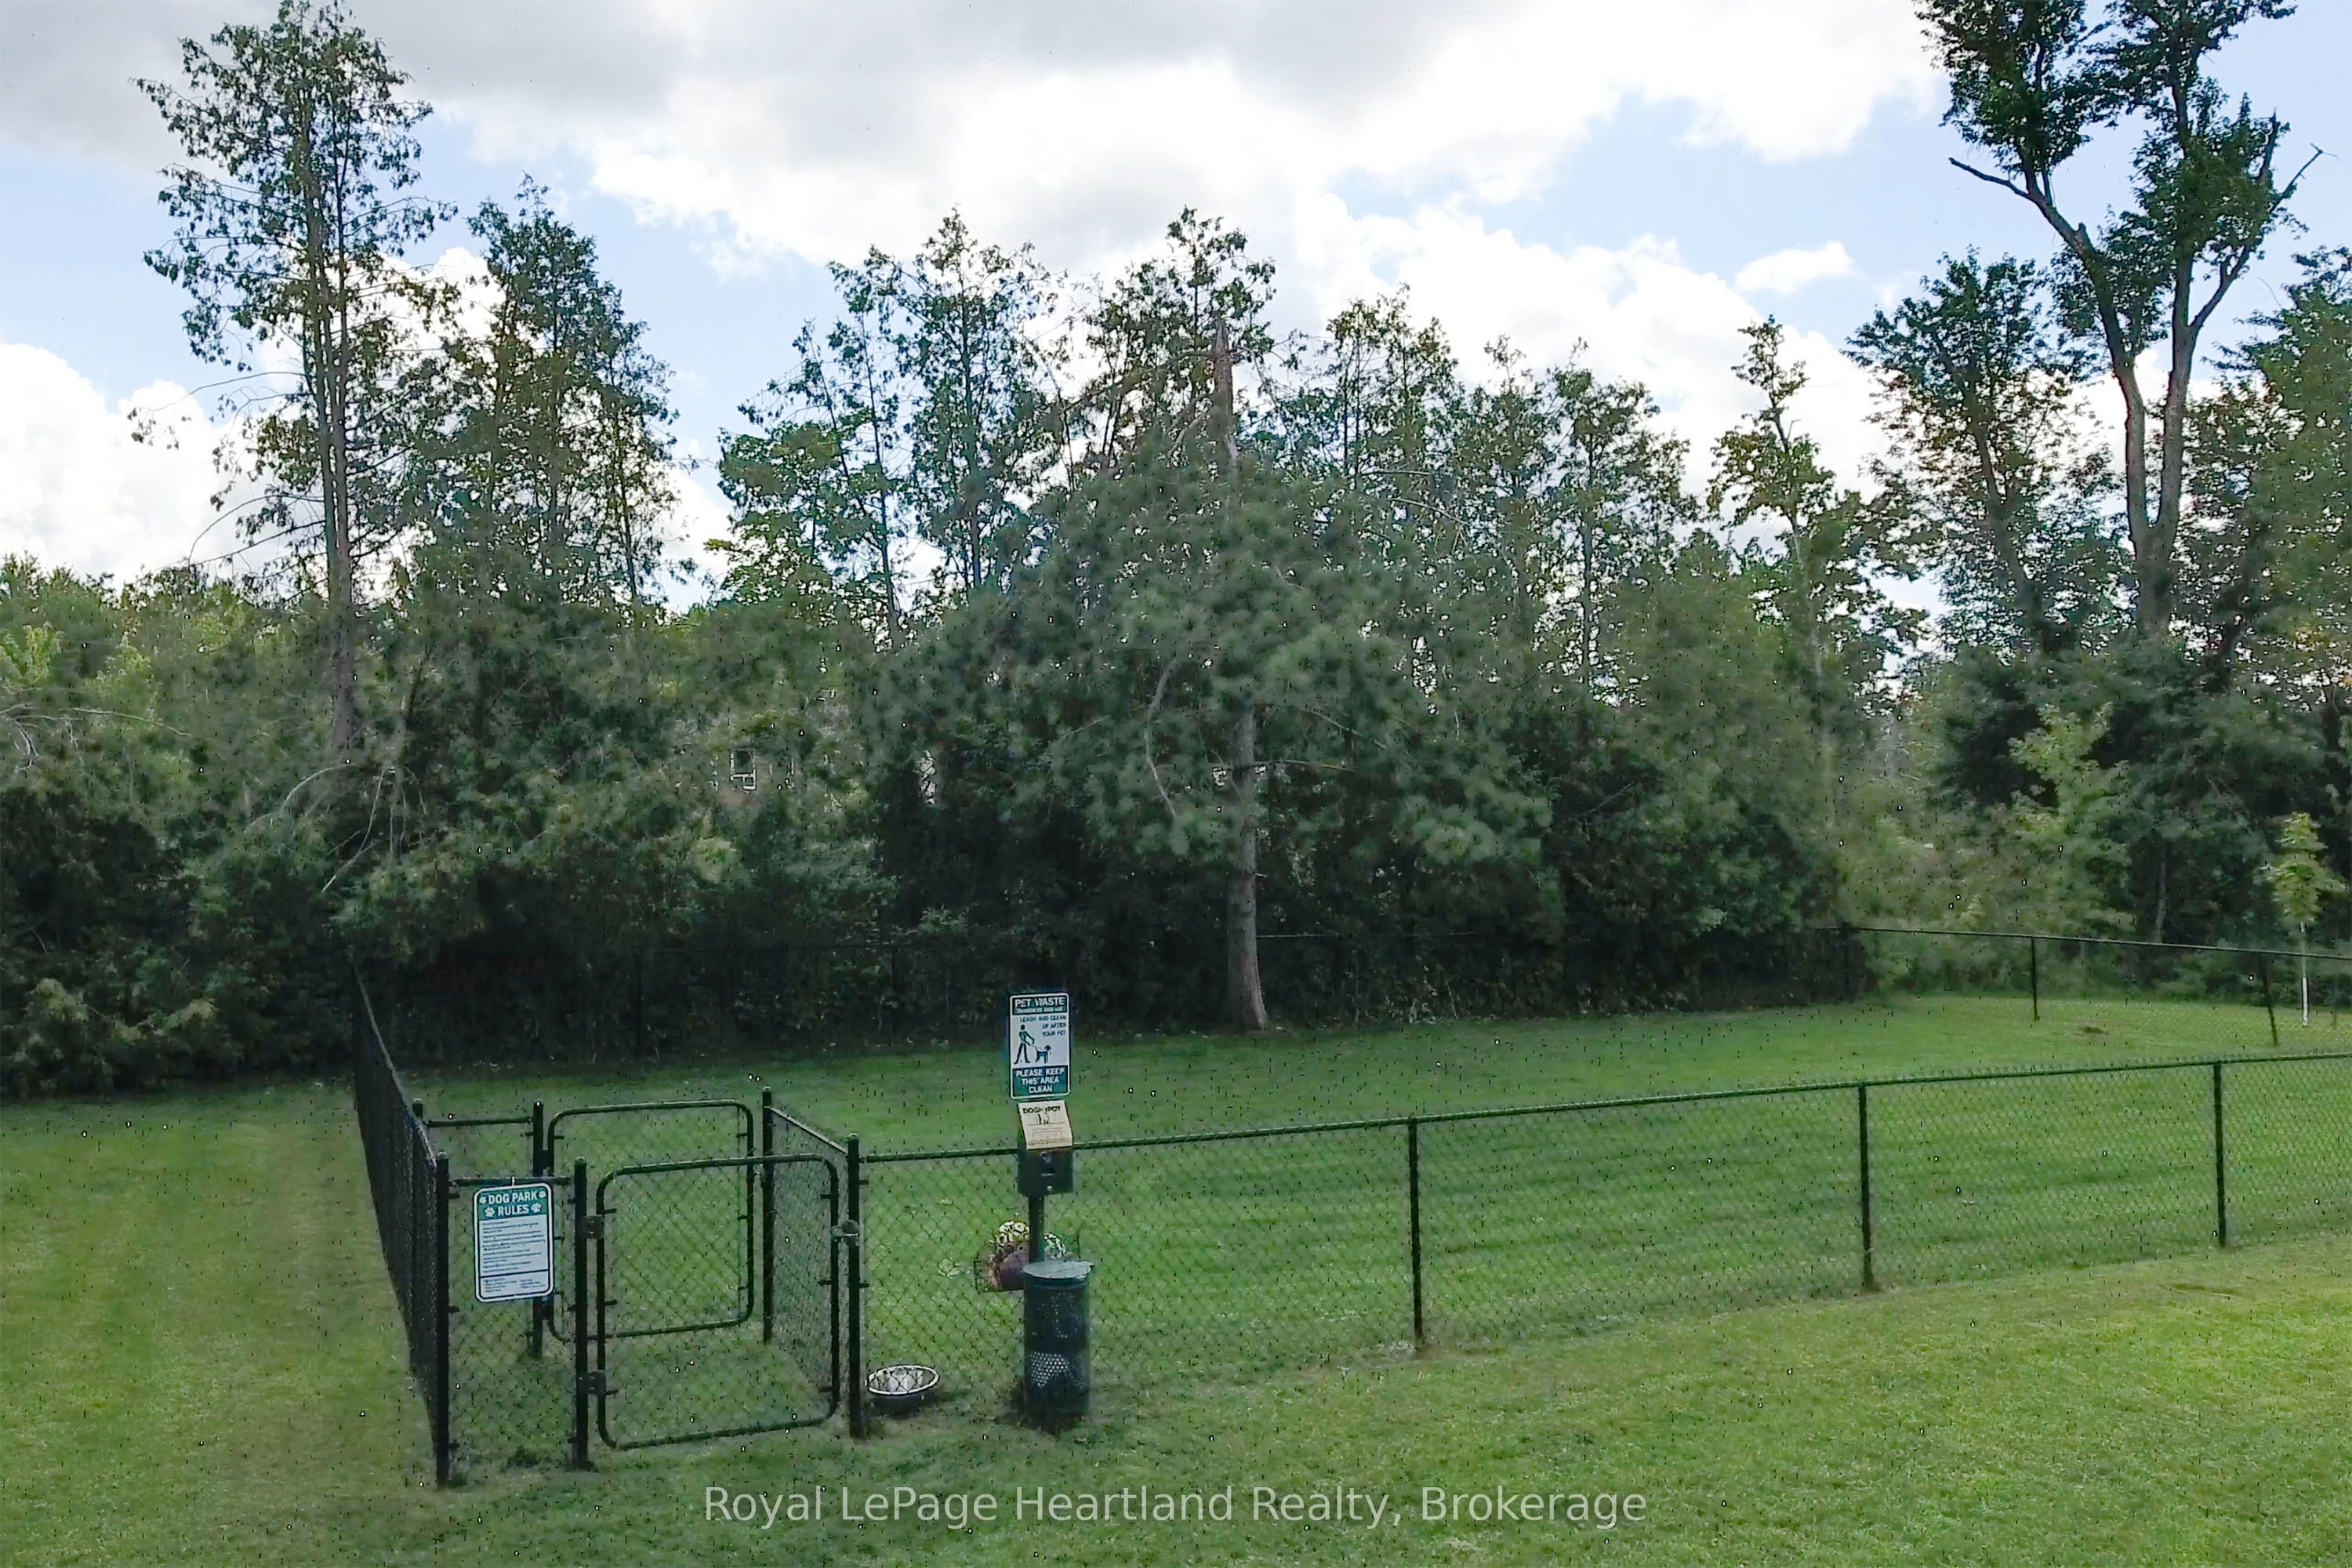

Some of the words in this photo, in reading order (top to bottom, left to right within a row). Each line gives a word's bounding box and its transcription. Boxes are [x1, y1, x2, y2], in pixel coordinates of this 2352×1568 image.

[1015, 999, 1031, 1007] PET
[1035, 997, 1065, 1006] WASTE
[1016, 1069, 1043, 1077] PLEASE
[1046, 1067, 1065, 1076] KEEP
[1040, 1076, 1059, 1084] AREA
[1029, 1085, 1053, 1094] CLEAN
[488, 1193, 510, 1205] DOG
[512, 1190, 538, 1203] PARK
[498, 1204, 530, 1217] RULES
